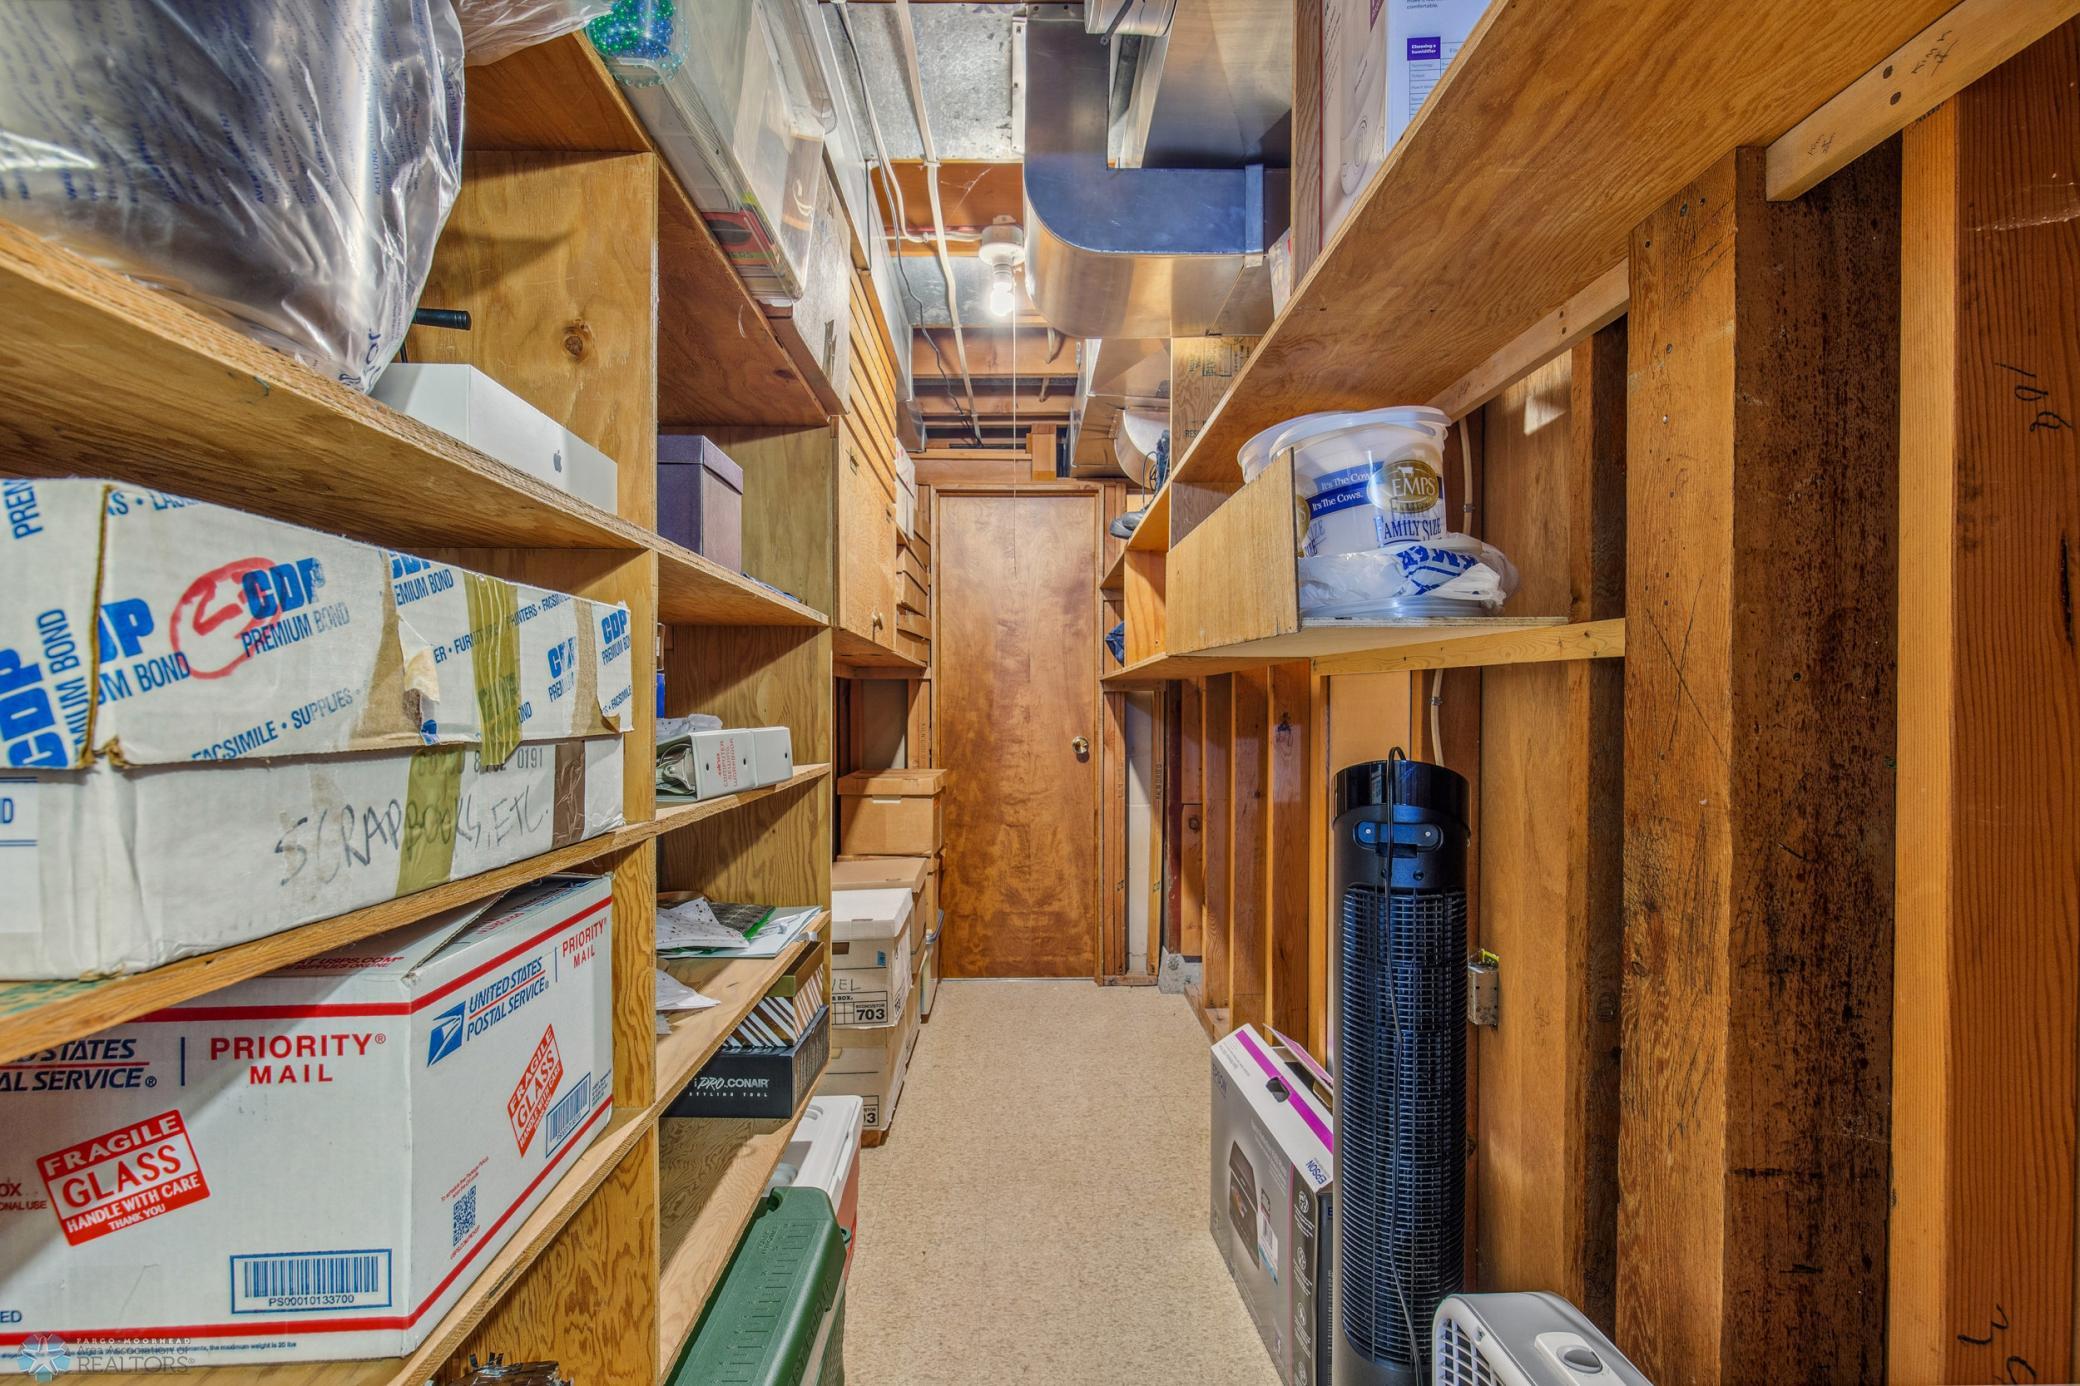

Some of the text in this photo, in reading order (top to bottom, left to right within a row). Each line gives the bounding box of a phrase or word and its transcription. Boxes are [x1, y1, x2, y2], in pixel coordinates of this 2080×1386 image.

[1350, 472, 1372, 482] Cow
[430, 568, 454, 595] BOND
[36, 609, 81, 674] BOND
[242, 613, 313, 657] PREMIUM
[601, 609, 628, 645] CDP
[135, 651, 191, 694] BOND
[290, 687, 353, 729] SUPPLIES
[562, 922, 605, 958] PRIORITY
[574, 944, 596, 969] MAIL
[469, 956, 544, 1013] UNITED STATES
[466, 976, 545, 1042] POSTAL SERVICE
[856, 1008, 885, 1021] 703
[250, 1063, 333, 1085] MAIL
[509, 1029, 553, 1114] FRAGILE
[517, 1050, 555, 1129] GLASS
[43, 1114, 181, 1177] FRAGILE
[61, 1143, 182, 1209] GLASS
[1305, 1159, 1328, 1185] EPSON
[66, 1173, 201, 1234] HANDLE WITH CARE
[108, 1203, 166, 1231] THANK YOU
